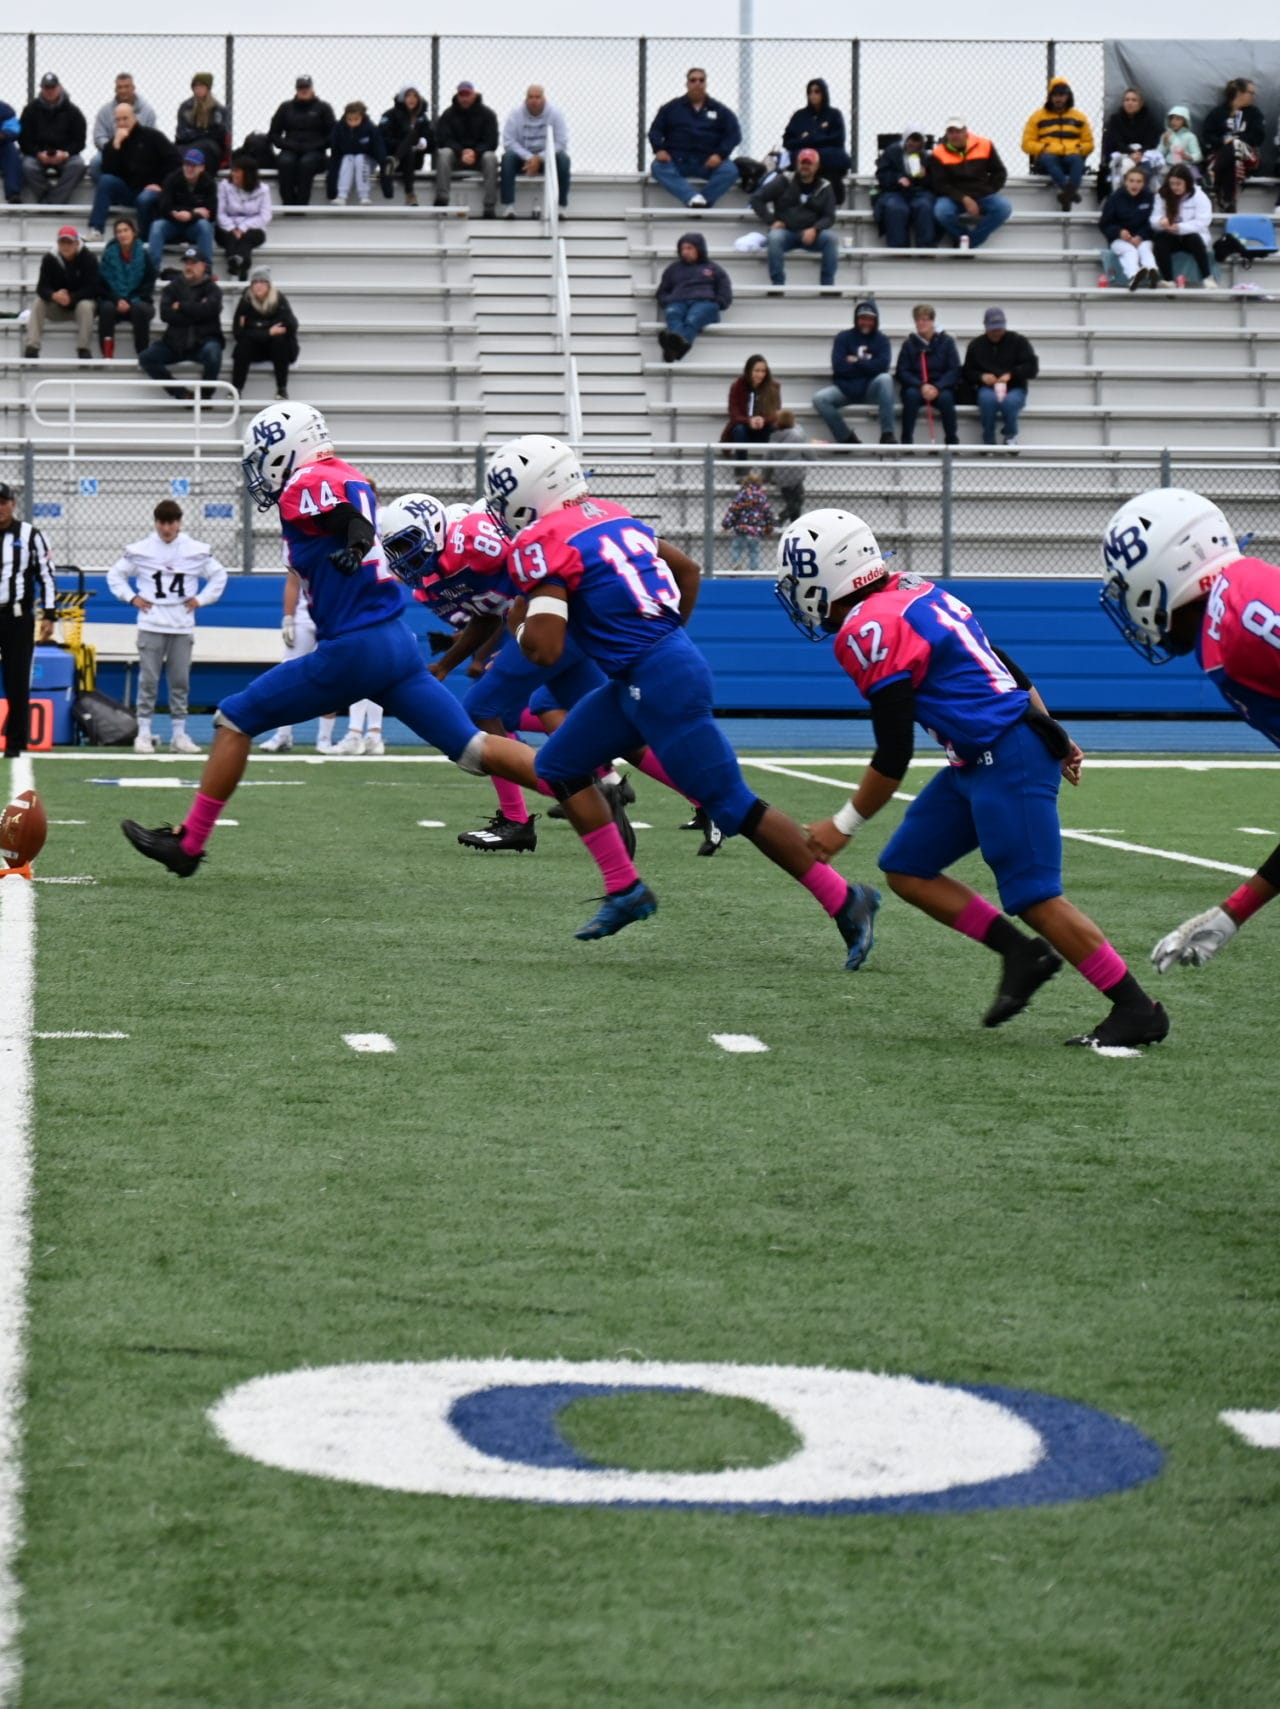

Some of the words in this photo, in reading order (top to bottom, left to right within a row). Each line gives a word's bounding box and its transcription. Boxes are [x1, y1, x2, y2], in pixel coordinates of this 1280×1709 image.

[252, 420, 286, 446] NB
[299, 480, 339, 516] 44
[488, 466, 518, 498] NB
[473, 519, 504, 558] 88
[782, 537, 819, 578] NB
[511, 542, 548, 583] 13
[600, 526, 682, 620] 13
[152, 570, 185, 599] 14
[846, 620, 889, 672] 12
